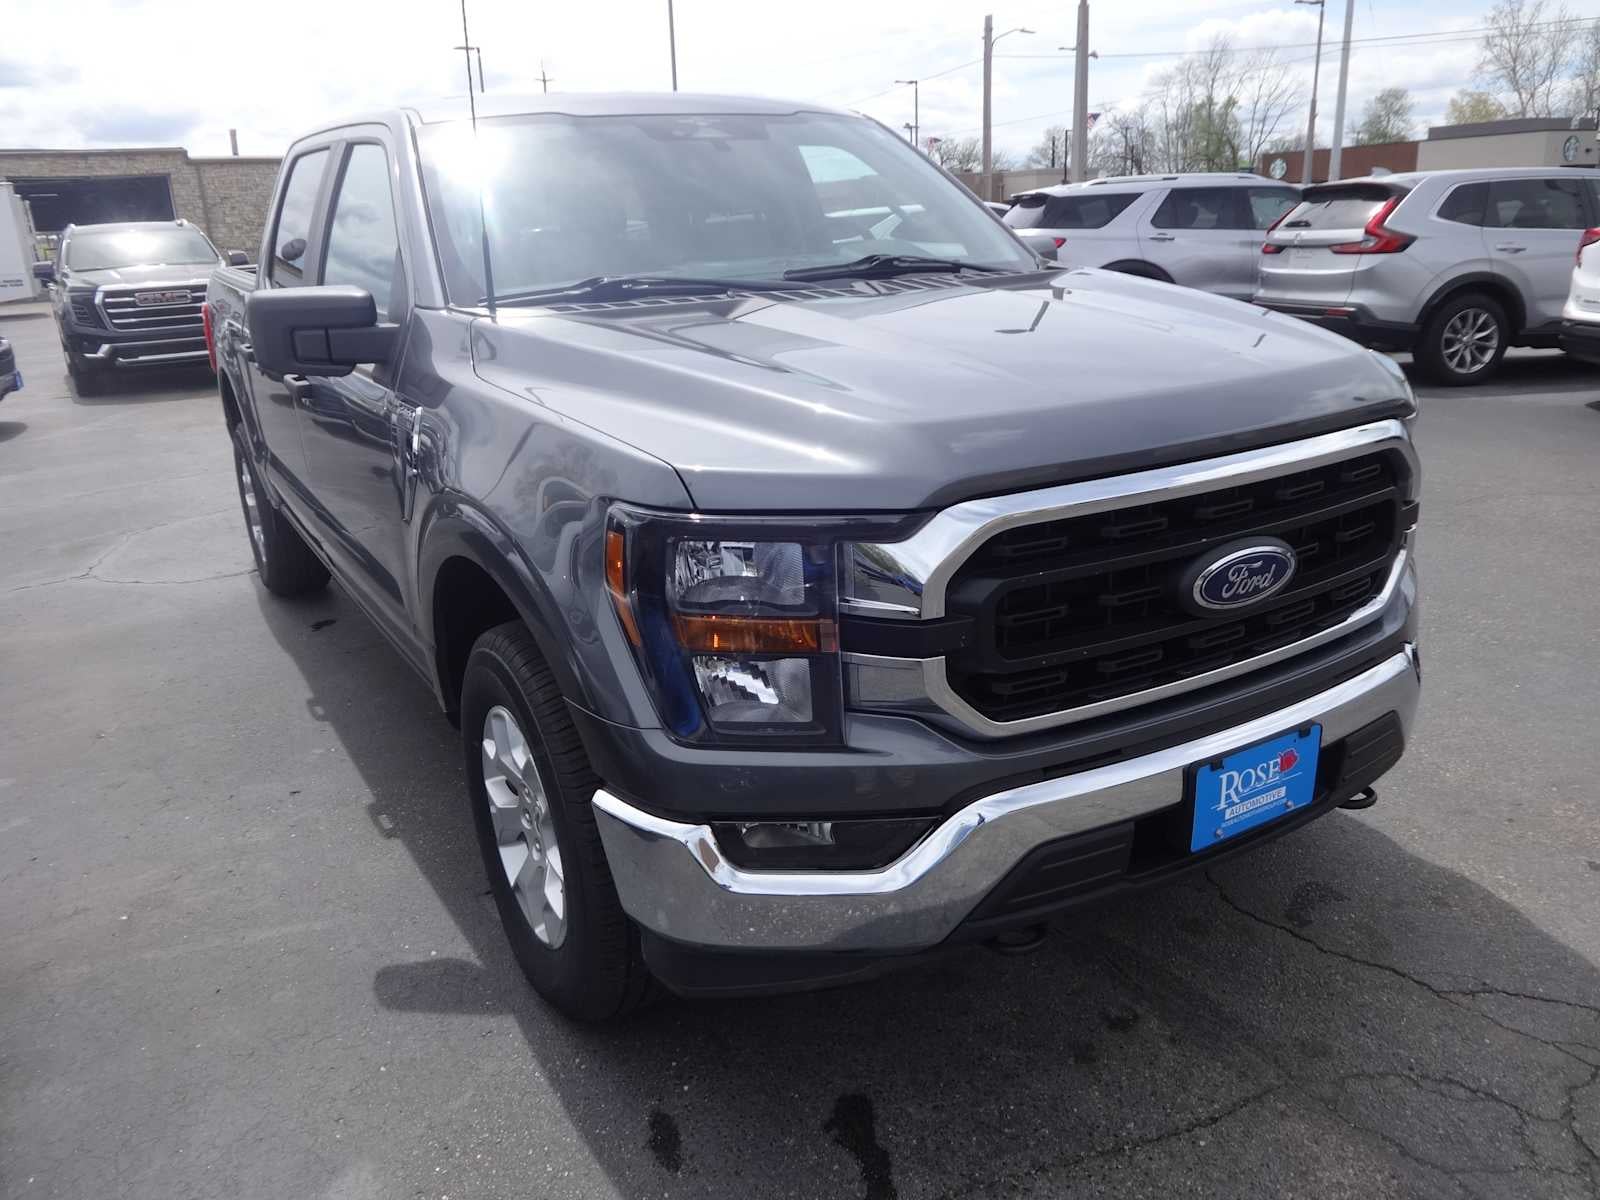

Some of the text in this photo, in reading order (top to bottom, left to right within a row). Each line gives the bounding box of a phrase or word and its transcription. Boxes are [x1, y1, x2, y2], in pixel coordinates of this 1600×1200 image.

[1222, 560, 1277, 598] Ford
[1217, 758, 1281, 811] ROSE
[1227, 788, 1283, 818] AUTOMOTIVE
